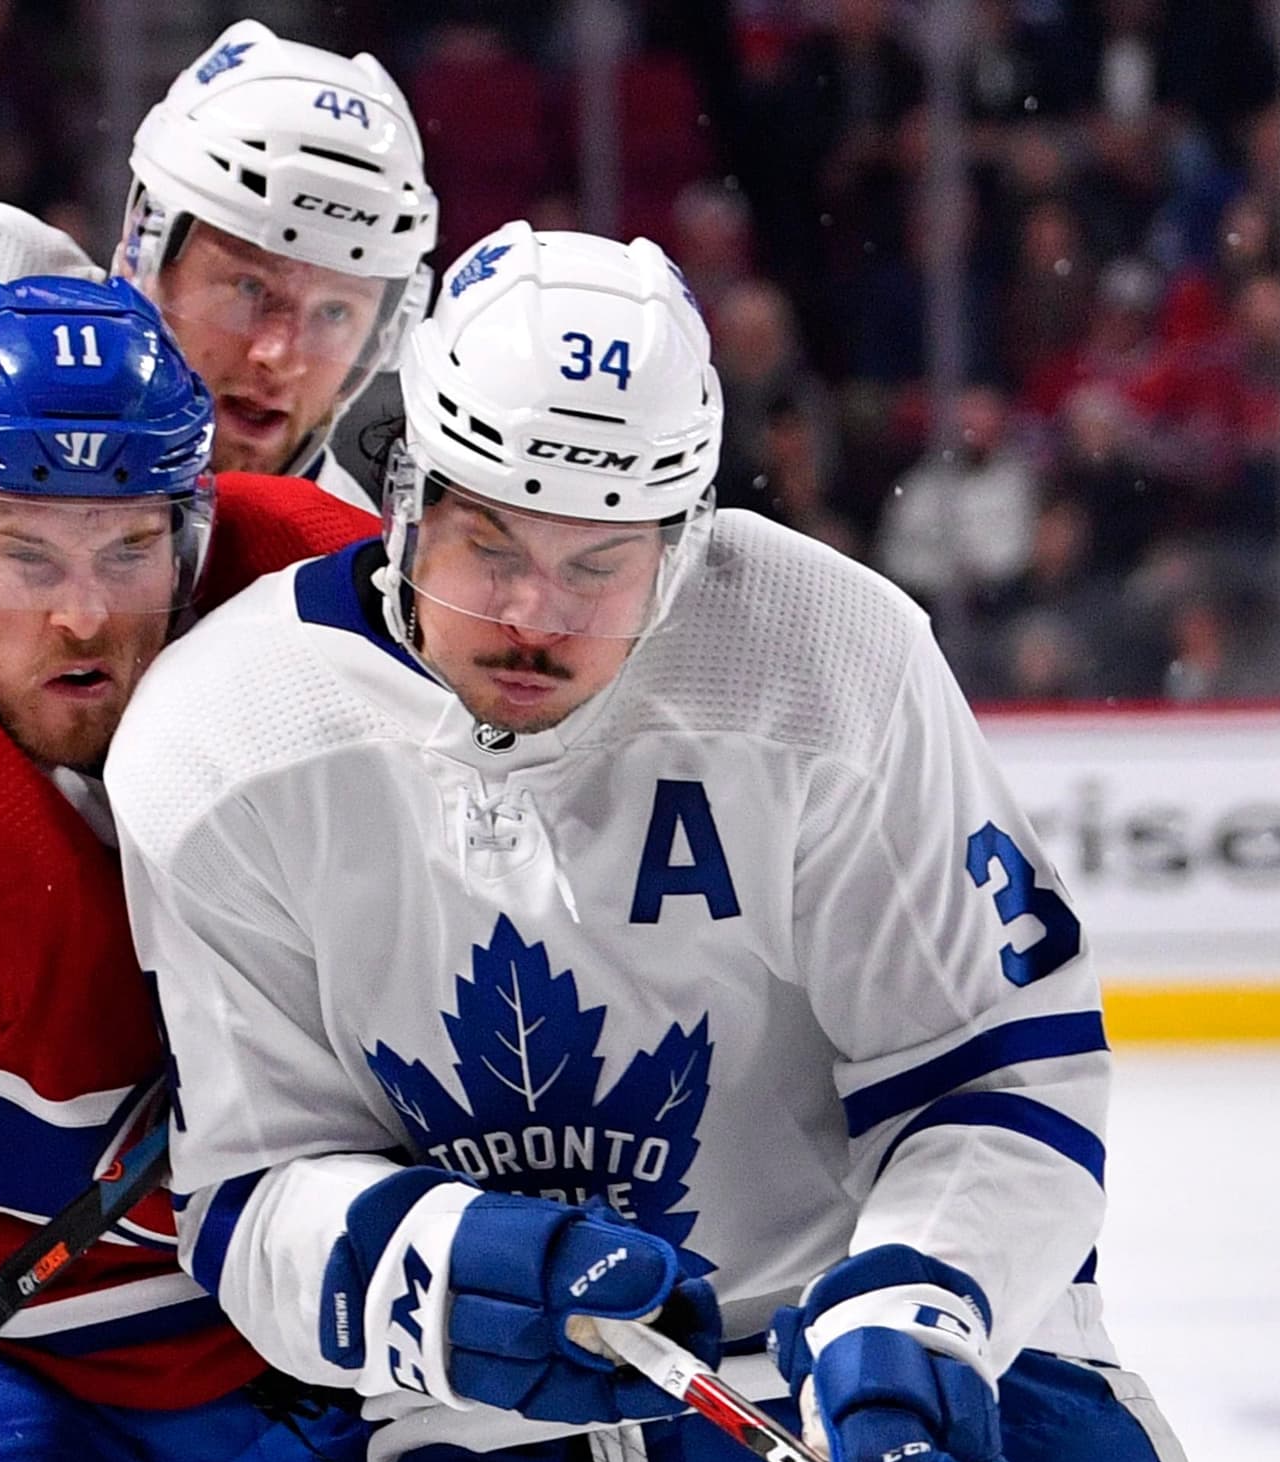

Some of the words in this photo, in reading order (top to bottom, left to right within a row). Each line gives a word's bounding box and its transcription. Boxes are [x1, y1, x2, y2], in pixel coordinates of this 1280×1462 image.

[313, 89, 370, 130] 44
[291, 192, 381, 227] CCM
[52, 324, 103, 367] 11
[559, 331, 632, 392] 34
[525, 437, 640, 472] CCM
[629, 779, 741, 924] A
[965, 819, 1082, 989] 3
[427, 1125, 670, 1183] TORONTO
[569, 1247, 629, 1298] CCM
[333, 1292, 350, 1349] MATTHEWS
